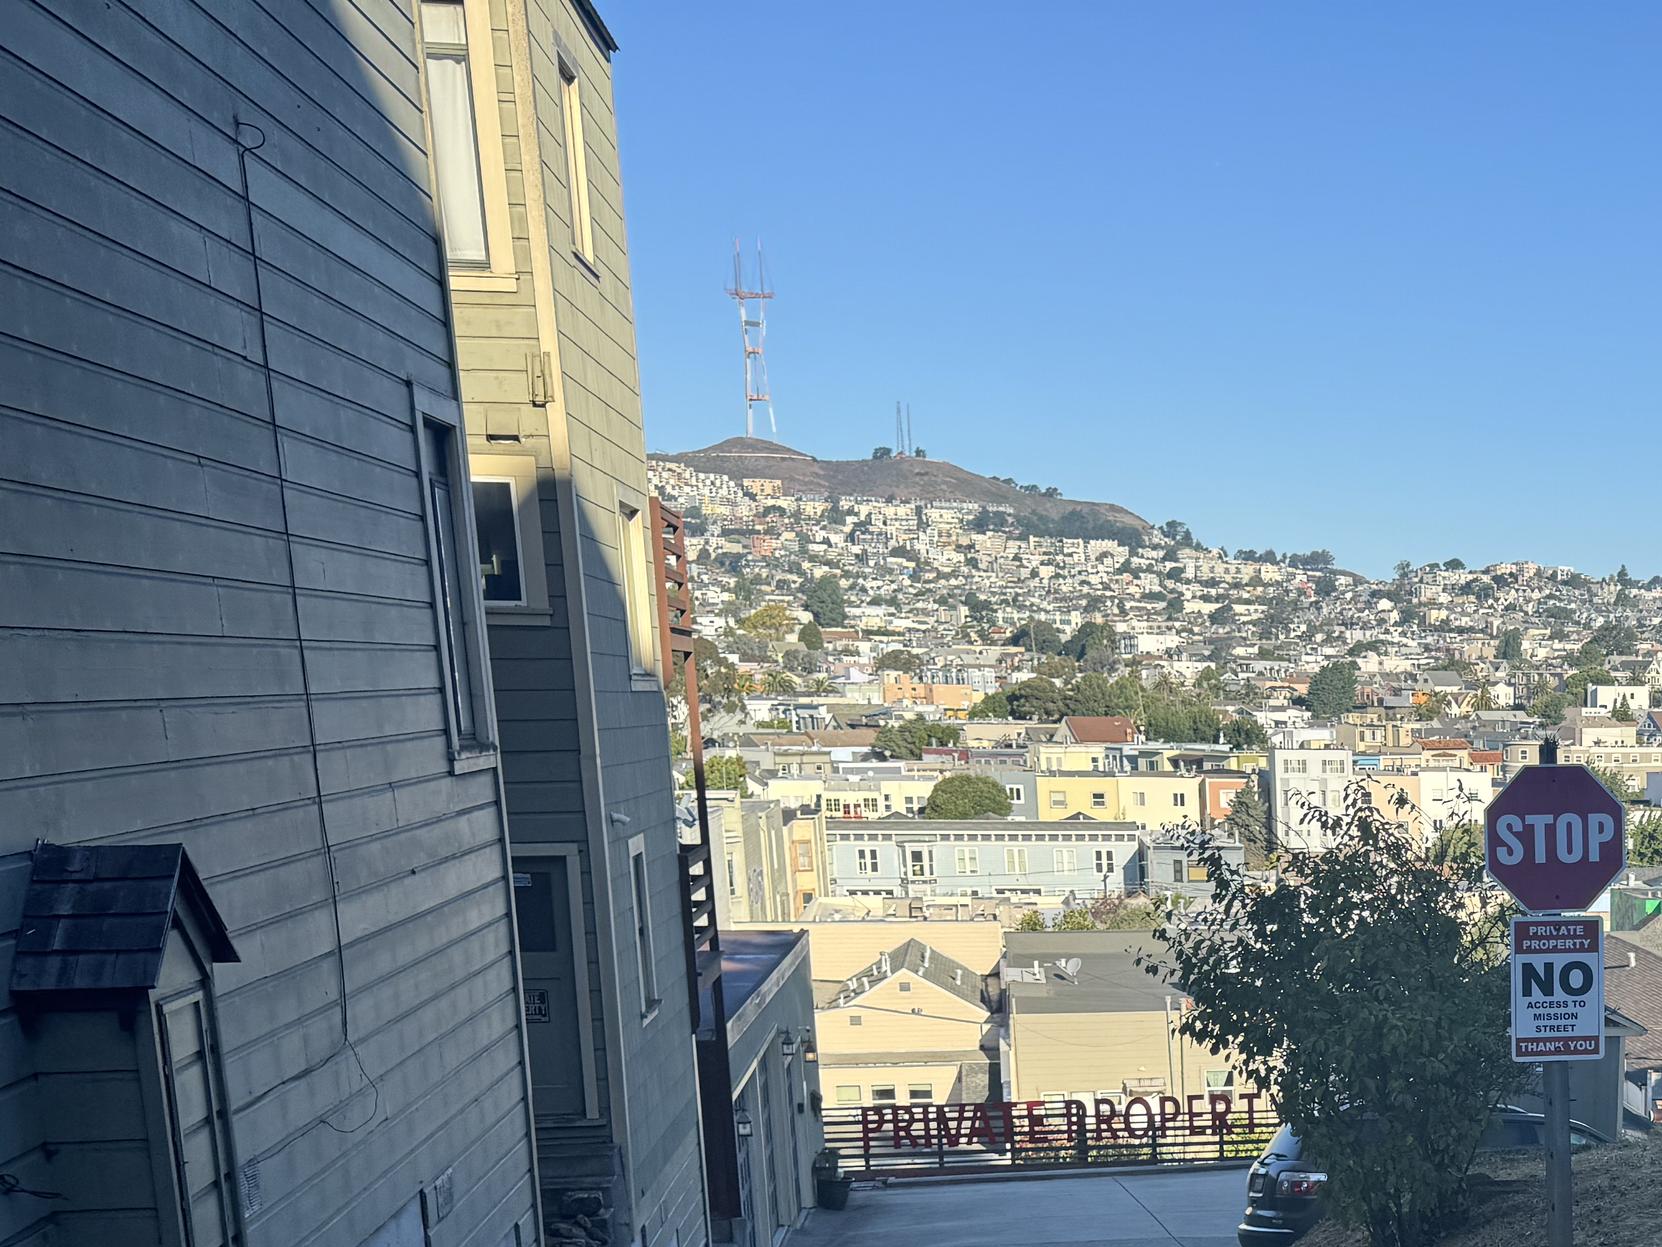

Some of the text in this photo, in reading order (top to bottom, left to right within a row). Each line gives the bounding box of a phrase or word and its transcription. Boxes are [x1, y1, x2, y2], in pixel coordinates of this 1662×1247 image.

[1495, 812, 1615, 866] STOP
[1529, 925, 1585, 936] PRIVATE
[1522, 939, 1591, 950] PROPERTY
[1521, 961, 1594, 998] NO
[1526, 1000, 1586, 1010] ACCESS TO
[1533, 1012, 1578, 1021] MISSION
[1535, 1024, 1576, 1033] STREET
[1520, 1040, 1595, 1052] THANK YOU
[862, 1101, 1050, 1150] PRIVATE
